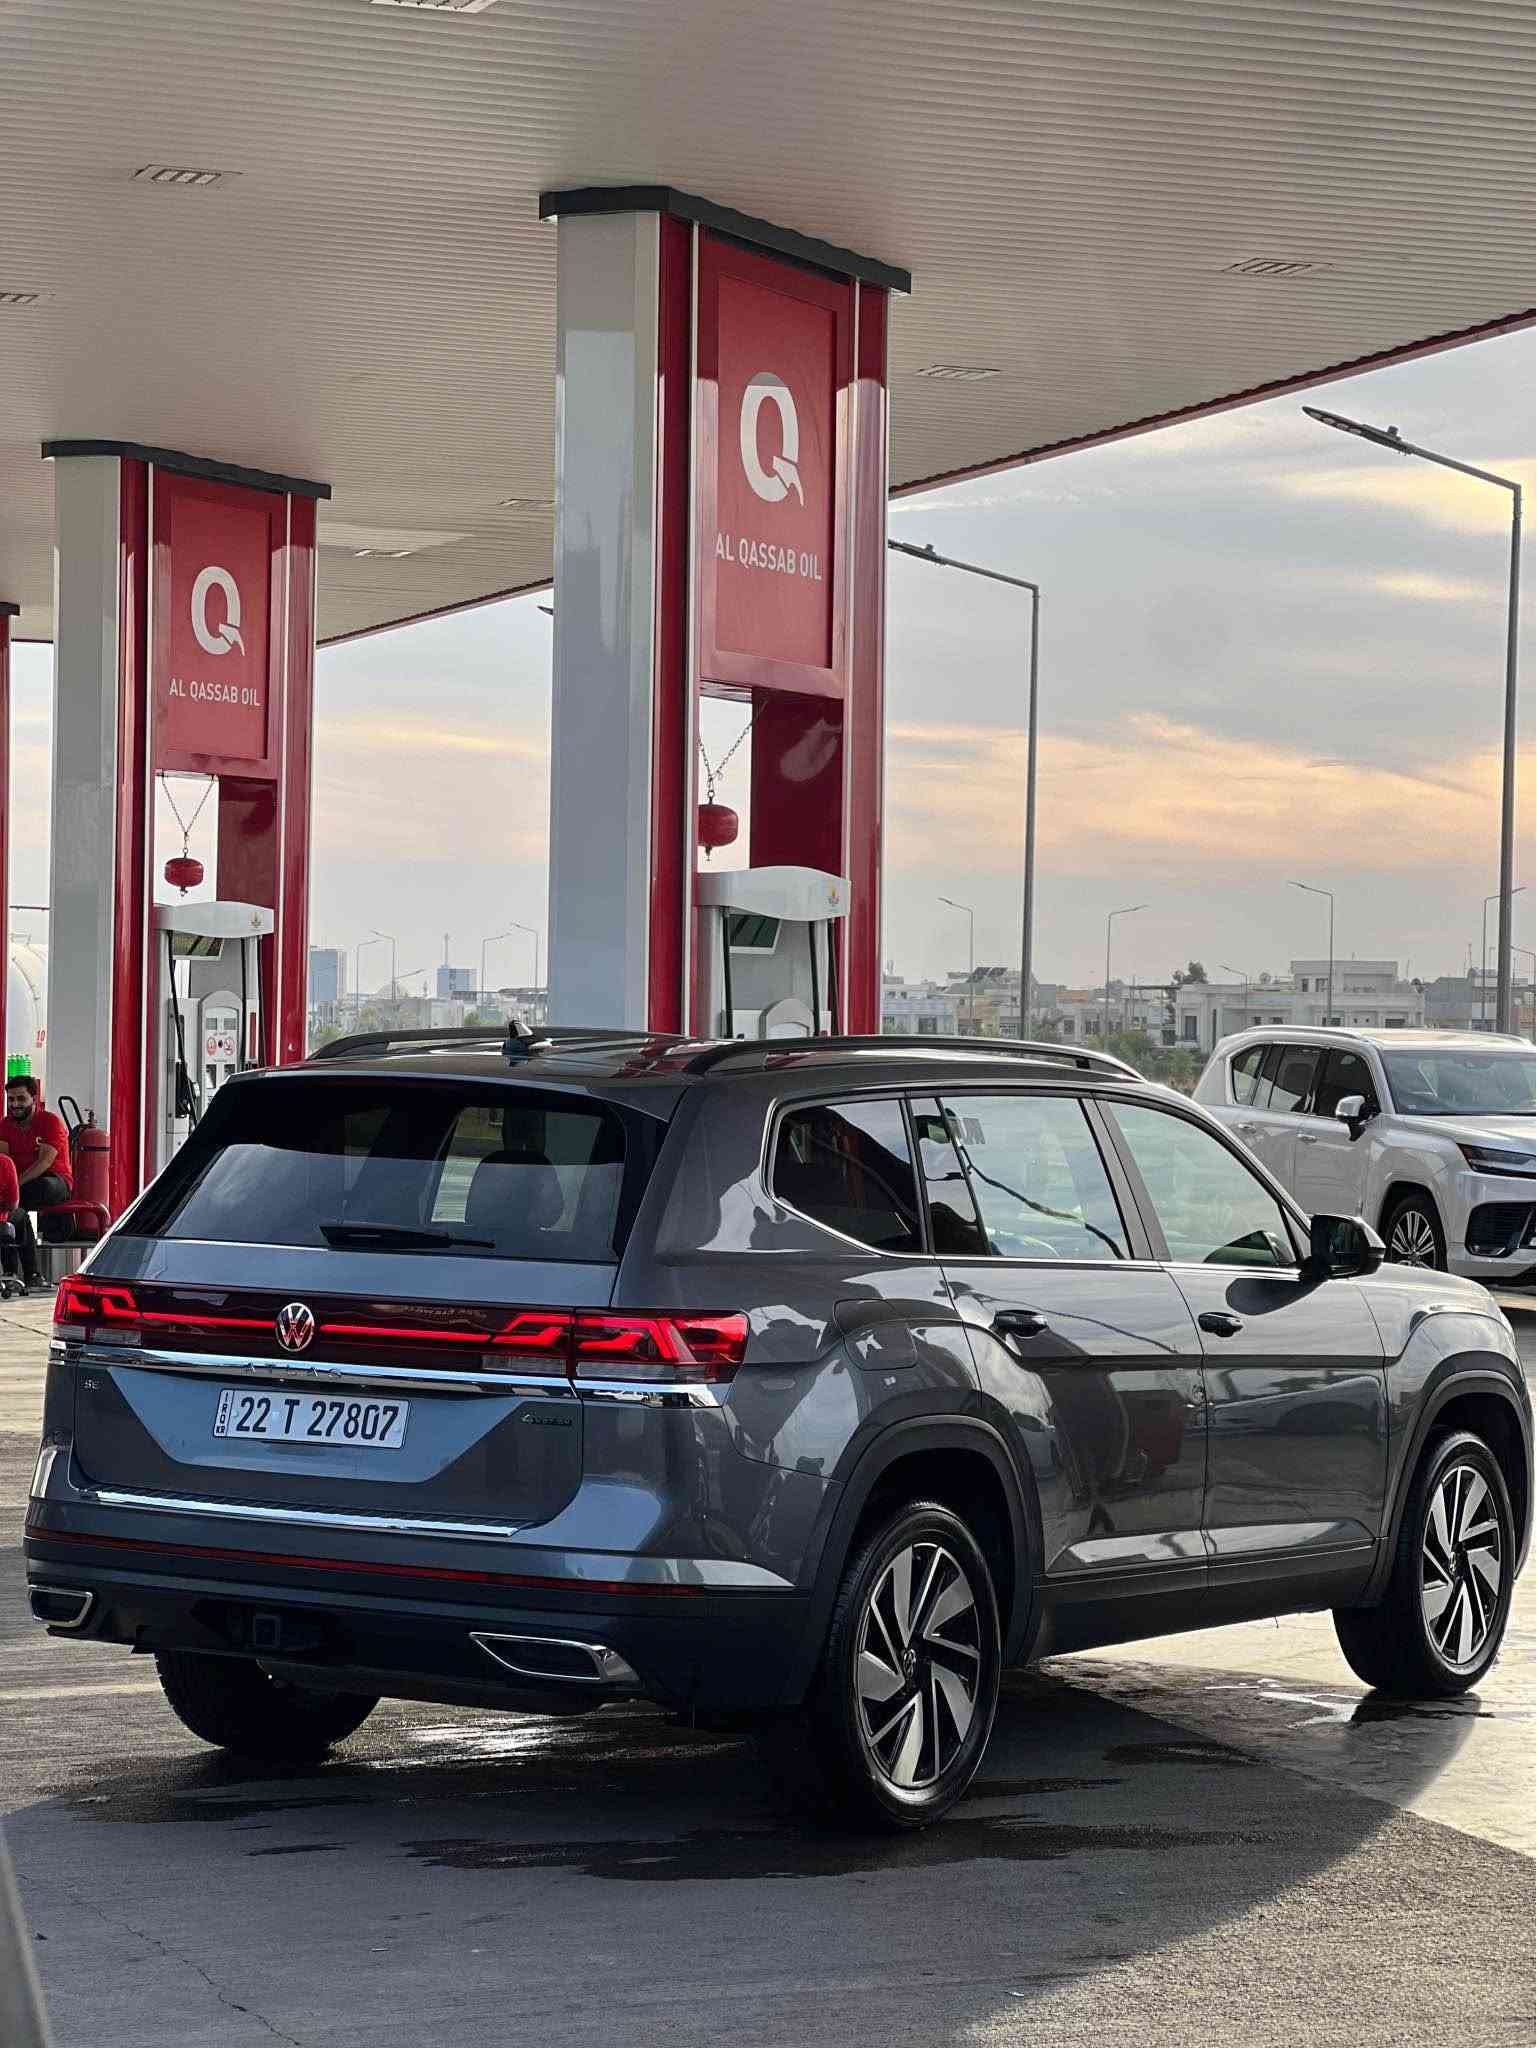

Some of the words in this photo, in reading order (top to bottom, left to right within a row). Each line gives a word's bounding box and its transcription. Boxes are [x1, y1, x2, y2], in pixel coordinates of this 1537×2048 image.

[740, 371, 804, 507] Q
[715, 533, 735, 561] AL
[739, 538, 796, 575] QASSAB
[800, 552, 822, 580] OIL
[191, 566, 245, 657] Q
[169, 678, 186, 697] AL
[190, 680, 238, 703] QASSAB
[241, 687, 260, 707] OIL
[236, 1396, 271, 1433] 22
[284, 1399, 300, 1434] T
[307, 1400, 400, 1441] 27807
